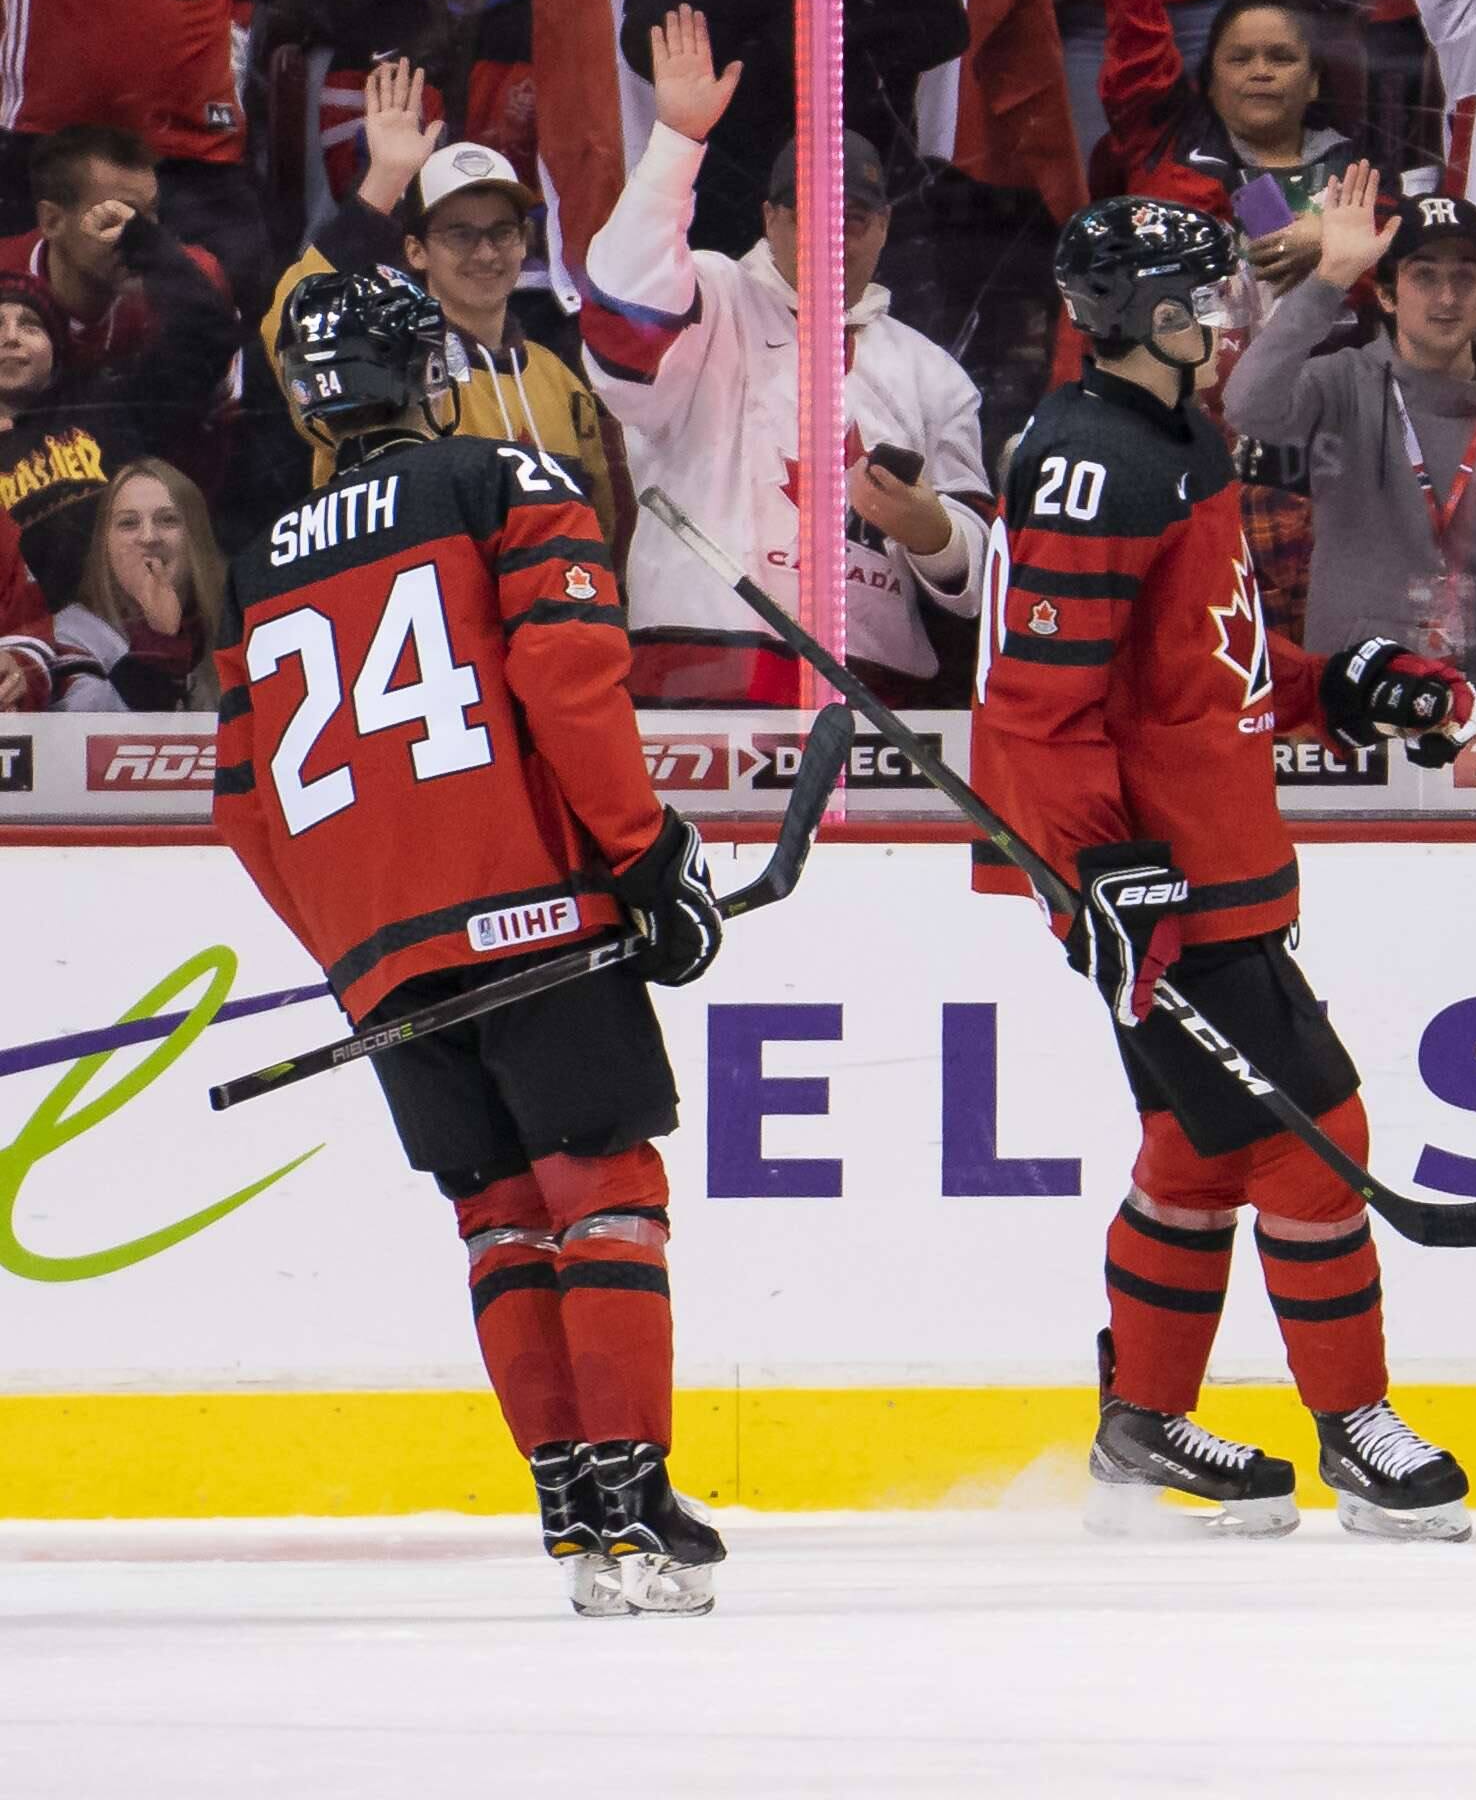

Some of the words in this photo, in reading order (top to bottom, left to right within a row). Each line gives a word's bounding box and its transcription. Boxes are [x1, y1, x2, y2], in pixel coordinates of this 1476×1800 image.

[315, 369, 344, 398] 24
[496, 446, 584, 498] 24
[1033, 456, 1107, 522] 20
[270, 475, 399, 567] SMITH
[767, 550, 904, 595] CADA
[247, 560, 496, 839] 24
[498, 901, 569, 942] IIHF
[332, 1022, 414, 1065] RIBCORE
[1151, 977, 1275, 1097] CCM
[1149, 1452, 1198, 1480] CCM
[1340, 1456, 1372, 1487] CCM
